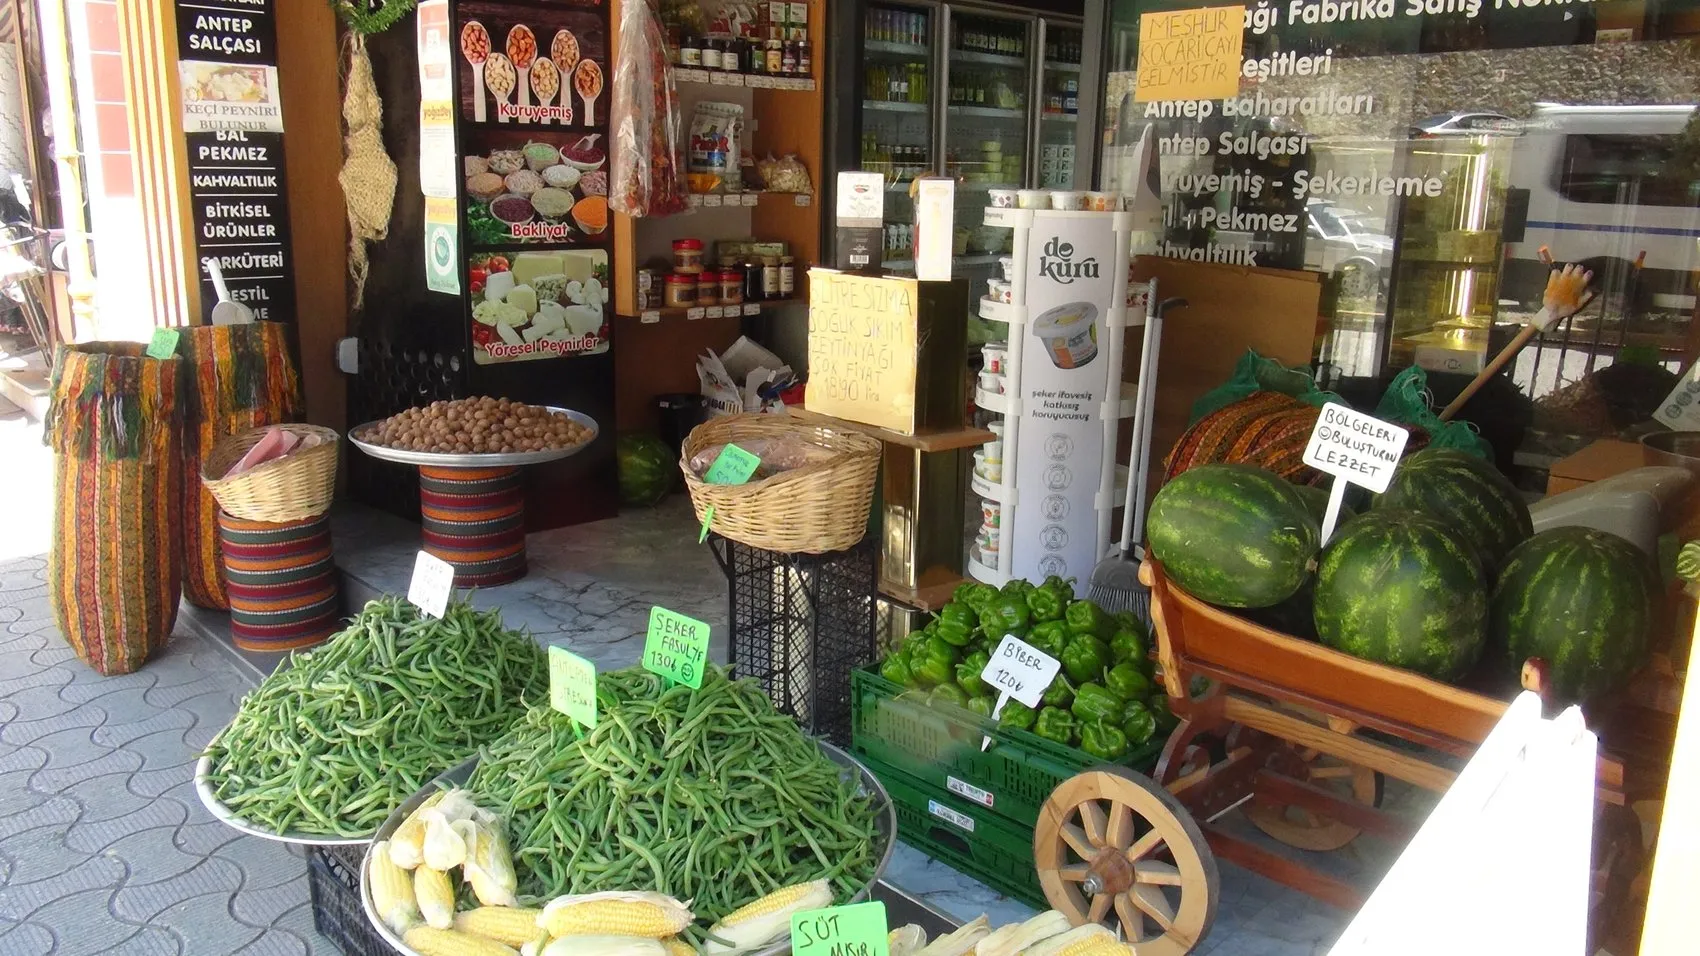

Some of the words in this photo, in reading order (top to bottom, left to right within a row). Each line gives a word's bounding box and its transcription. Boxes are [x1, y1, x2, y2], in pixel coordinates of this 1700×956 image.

[195, 15, 252, 33] ANTEP
[1288, 0, 1395, 26] Fabrika
[189, 34, 261, 54] SALÇASI
[1204, 35, 1238, 61] ÇAYI
[1240, 48, 1333, 83] eşitleri
[184, 103, 217, 116] KEÇİ
[222, 104, 278, 117] PEYNİRİ
[499, 102, 573, 121] Kuruyemiş
[1144, 100, 1213, 123] Antep
[1222, 89, 1374, 116] Baharatları
[200, 119, 268, 131] BULUNUR
[216, 130, 249, 142] BAL
[199, 146, 268, 161] PEKMEZ
[1159, 132, 1211, 161] ntep
[1218, 131, 1307, 160] Salçası
[193, 175, 278, 188] KAHVALTILIK
[1292, 169, 1443, 200] Şekerleme
[205, 202, 271, 218] BİTKİSEL
[1201, 207, 1299, 233] Pekmez
[203, 222, 277, 239] ÜRÜNLER
[511, 222, 568, 239] Bakliyat
[231, 285, 270, 301] ESTİL
[485, 340, 537, 358] Yöresel
[540, 335, 600, 354] Peynirler
[846, 361, 883, 387] FİYAT
[1313, 443, 1382, 478] LEZZET
[661, 635, 704, 665] FASULYE
[1003, 642, 1042, 671] BİBER
[798, 914, 840, 949] SÜT
